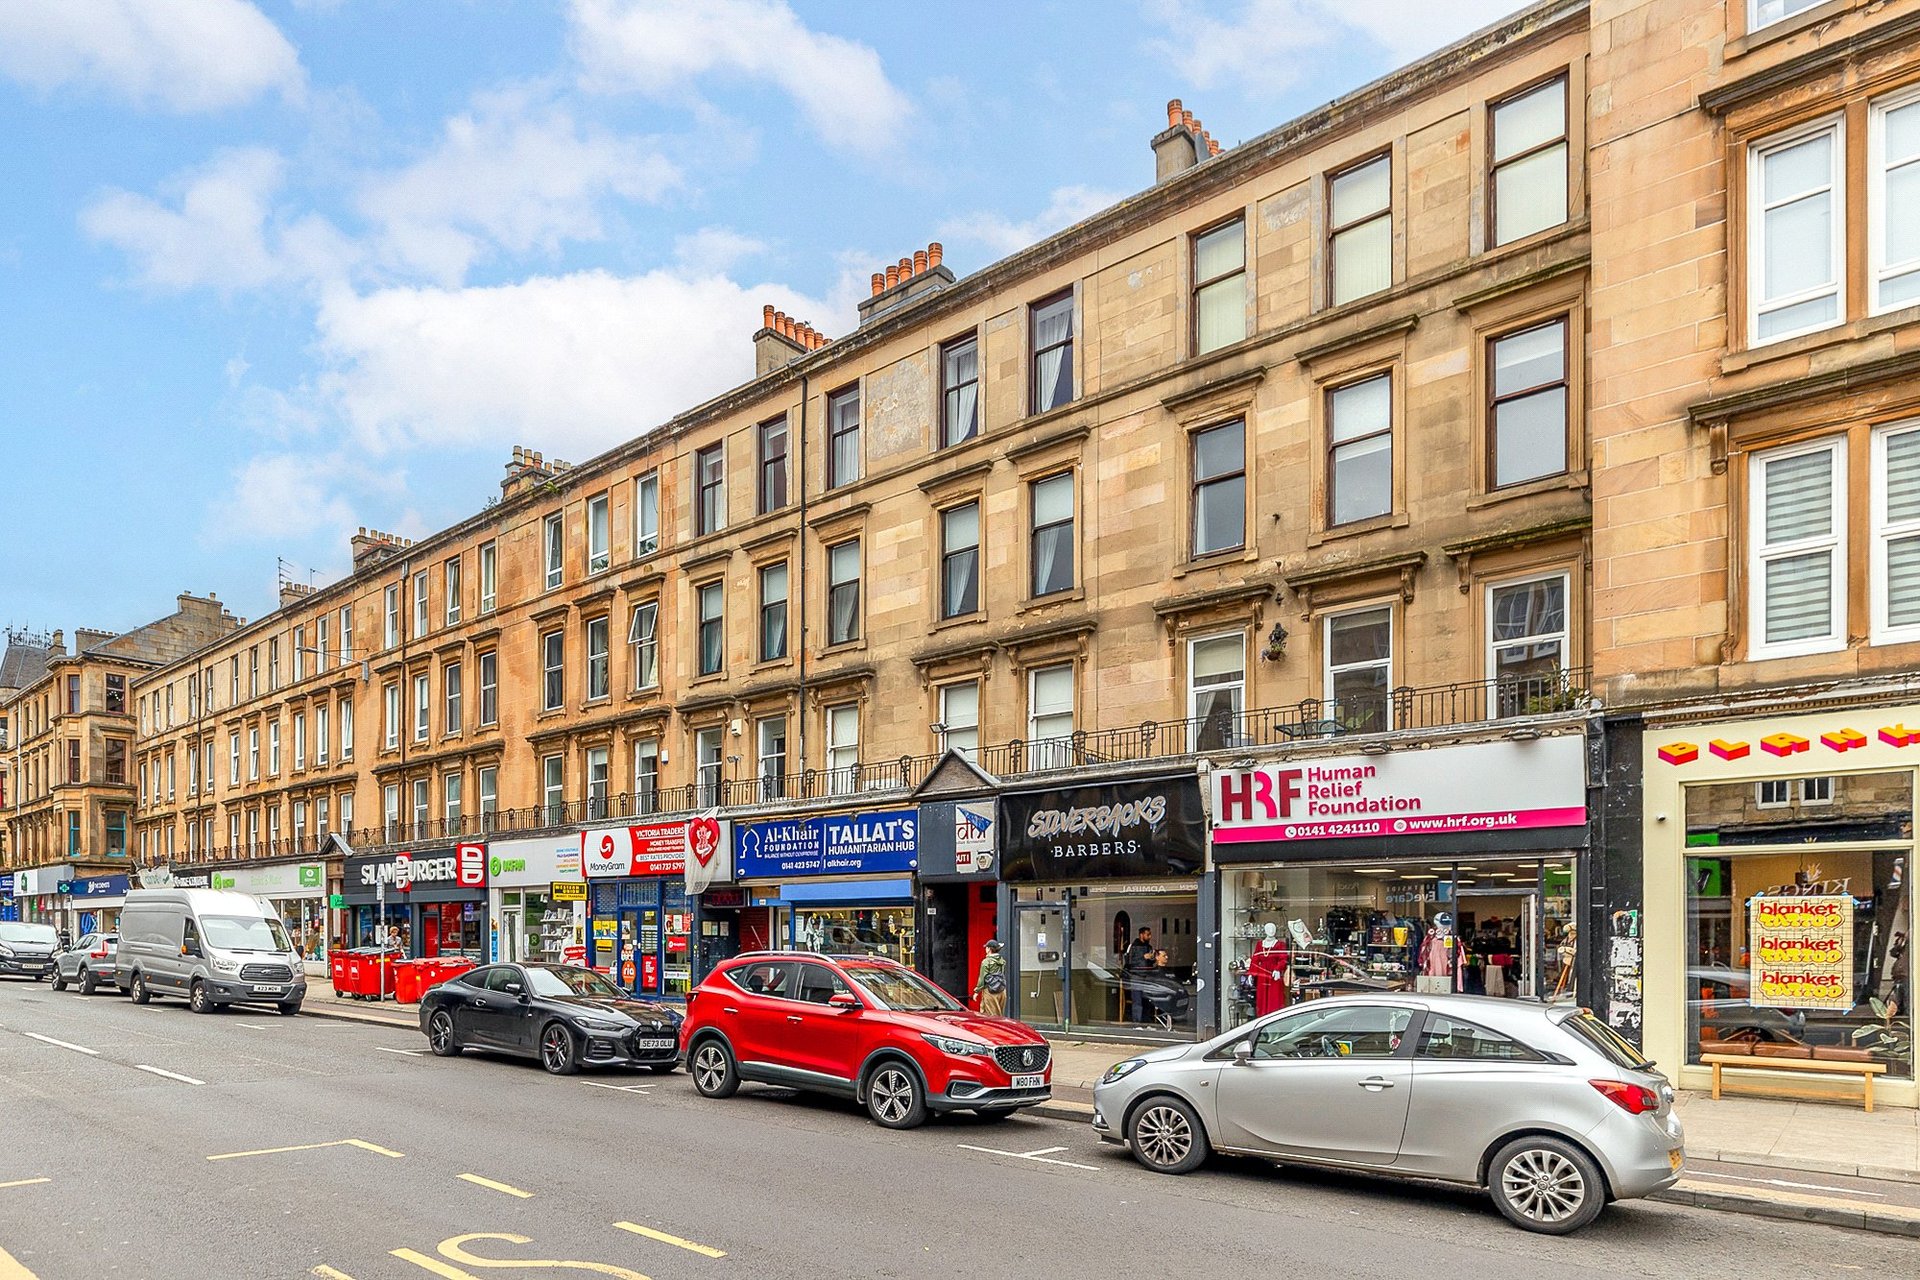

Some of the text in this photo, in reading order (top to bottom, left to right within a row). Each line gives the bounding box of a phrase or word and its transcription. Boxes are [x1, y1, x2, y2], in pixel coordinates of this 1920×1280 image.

[1307, 765, 1376, 782] Human
[1221, 768, 1303, 821] HRF
[1308, 781, 1363, 799] Relief
[1308, 796, 1421, 816] Foundation
[1027, 795, 1167, 839] SILVERBACKS
[1409, 813, 1517, 830] www.hrf.org.uk
[636, 827, 684, 838] VICTORIA TRADERS
[765, 825, 819, 843] Al-Khair
[829, 819, 915, 844] TALLAT'S
[1297, 822, 1380, 837] 0141 4241110
[764, 841, 819, 852] FOUNDATION
[828, 841, 915, 855] HUMANITARIAN HUB
[1053, 840, 1137, 858] BARBERS
[590, 861, 625, 872] MoneyGram
[827, 859, 862, 868] alkhair.org
[361, 856, 457, 888] SLAMBURGER
[1760, 902, 1839, 915] blanket
[1758, 913, 1843, 928] TATTOO
[1760, 937, 1840, 950] blanket
[1759, 948, 1844, 963] TATTOO
[1762, 971, 1841, 985] blanket
[1761, 982, 1845, 998] TATTOO
